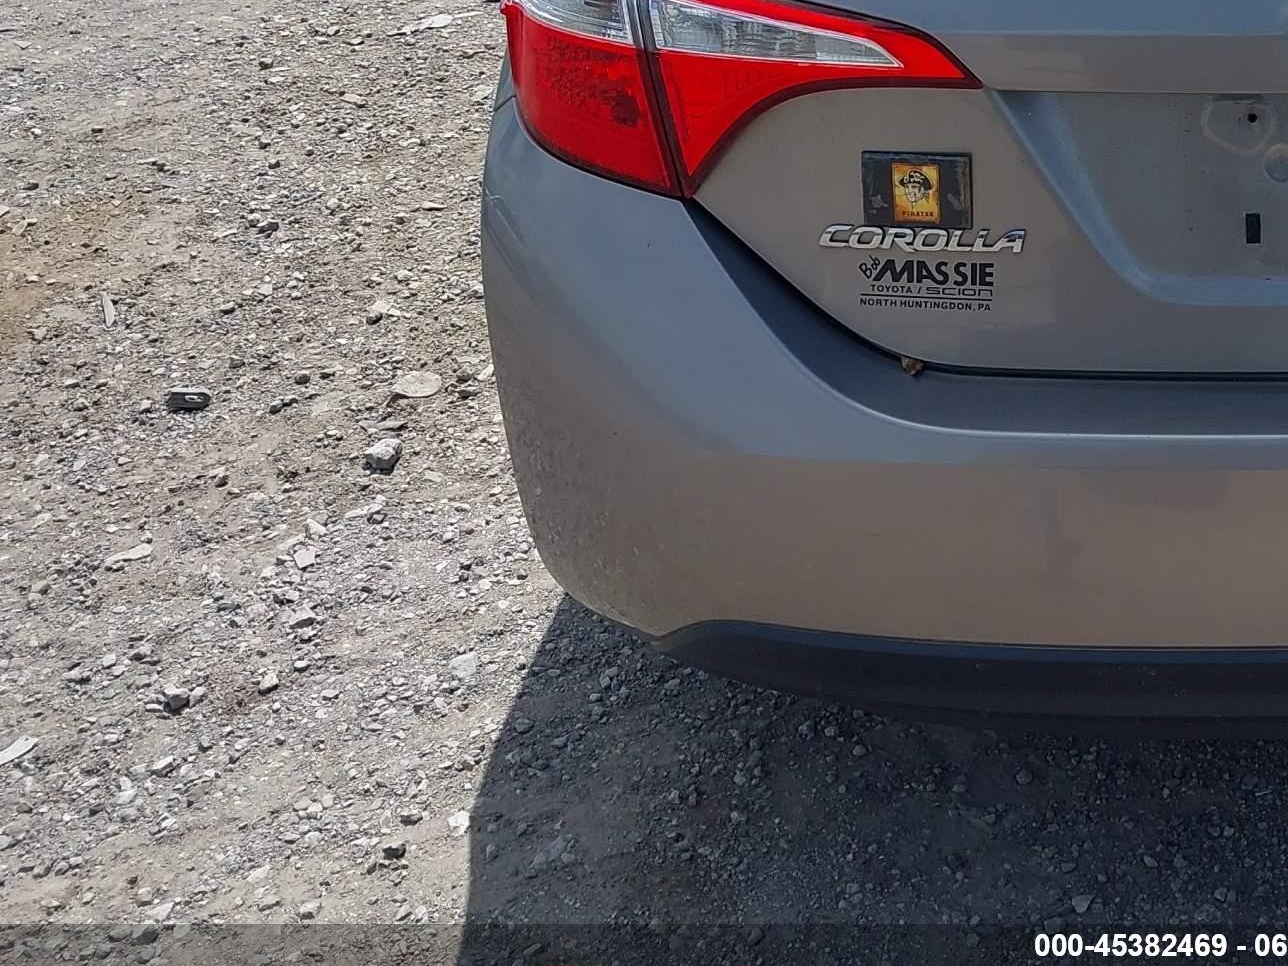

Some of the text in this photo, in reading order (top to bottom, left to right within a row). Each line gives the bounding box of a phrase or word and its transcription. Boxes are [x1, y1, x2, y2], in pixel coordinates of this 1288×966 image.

[819, 224, 1026, 253] COROLLA
[859, 254, 994, 286] Bob MASSIE
[870, 284, 913, 294] TOYOTA
[859, 298, 991, 312] NORTH HUNTINGDON, PA
